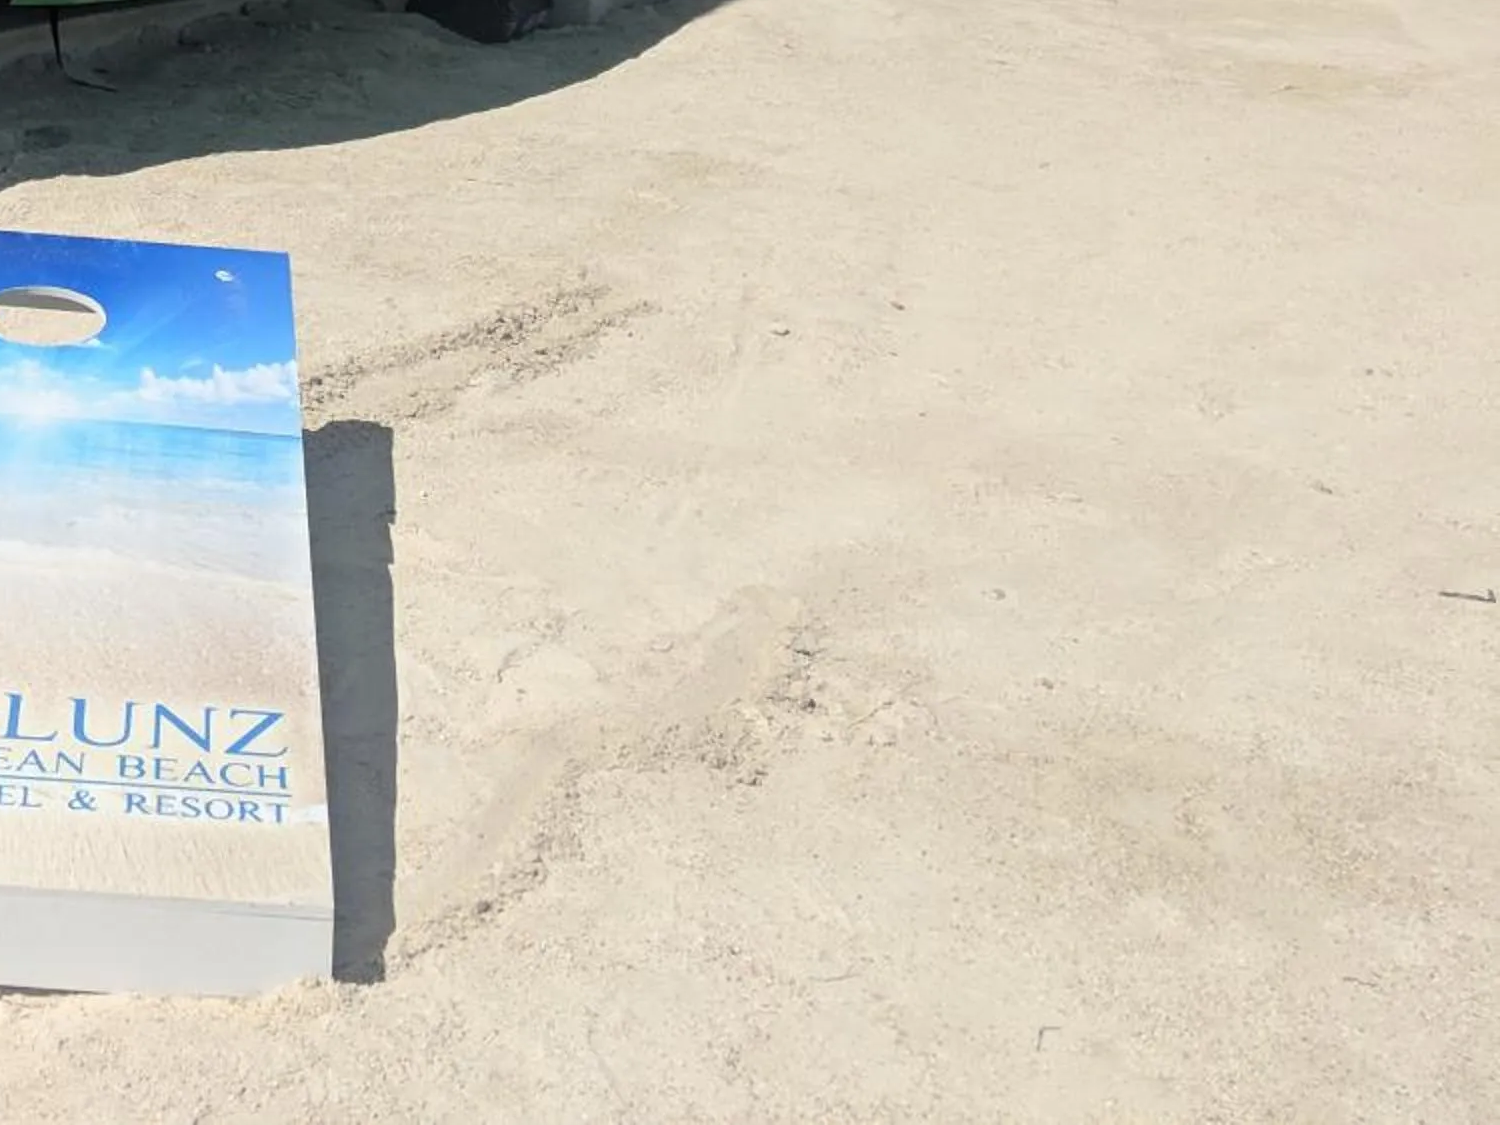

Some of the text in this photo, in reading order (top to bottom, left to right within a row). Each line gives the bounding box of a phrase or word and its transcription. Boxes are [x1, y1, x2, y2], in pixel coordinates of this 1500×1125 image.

[119, 755, 288, 790] BEACH
[69, 789, 97, 812] &
[125, 793, 288, 824] RESORT
